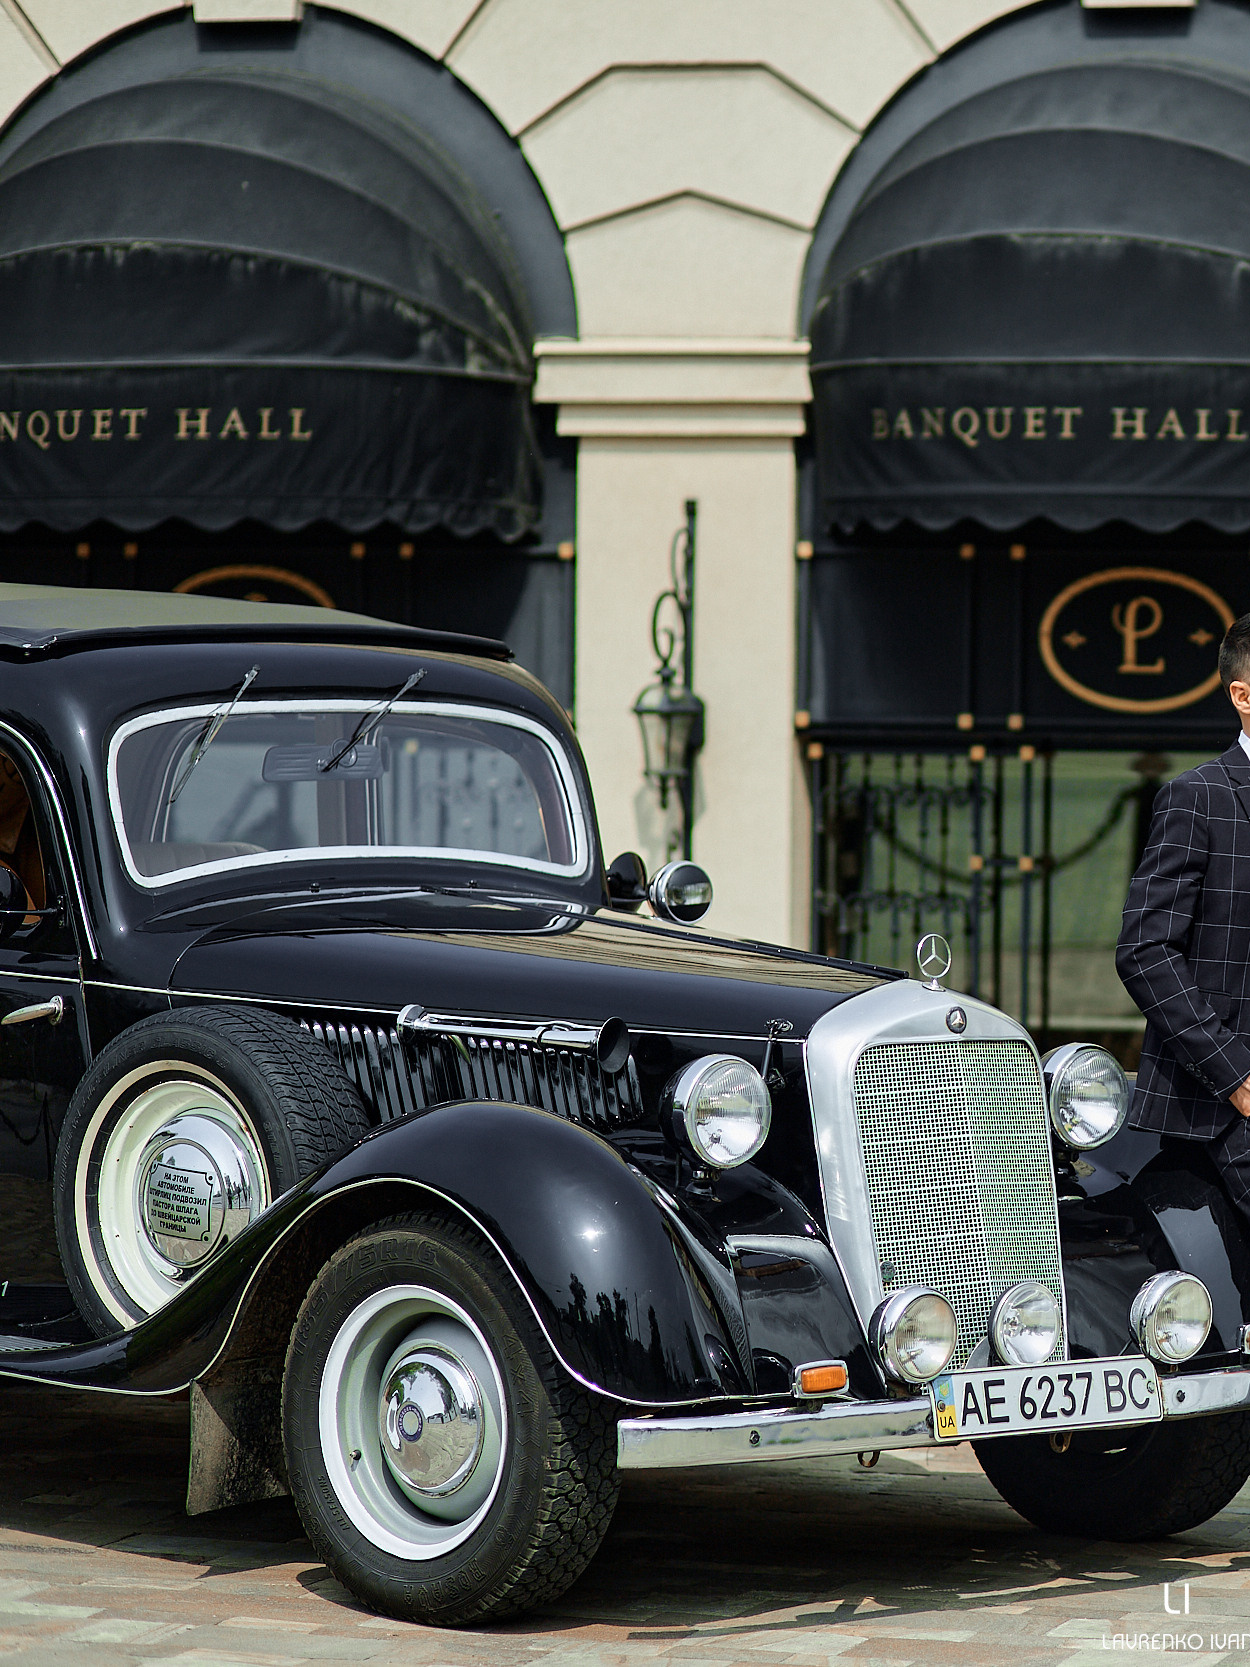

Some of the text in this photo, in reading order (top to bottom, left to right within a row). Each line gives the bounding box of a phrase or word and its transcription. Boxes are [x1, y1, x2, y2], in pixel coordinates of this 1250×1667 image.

[175, 408, 313, 441] HALL
[872, 407, 1249, 447] BANQUET HALL
[172, 1174, 188, 1183] ЭТОМ
[157, 1180, 195, 1194] АВТОМОБИЛЕ
[152, 1199, 199, 1216] ПАСТОРА ШЛАГА
[172, 1194, 207, 1206] ПОДВОЗИЛ
[157, 1210, 201, 1226] ШВЕЙЦАРСКОЙ
[159, 1220, 187, 1233] ГРАНИЦЫ
[961, 1367, 1151, 1427] AE 6237 BC
[940, 1416, 956, 1429] UA
